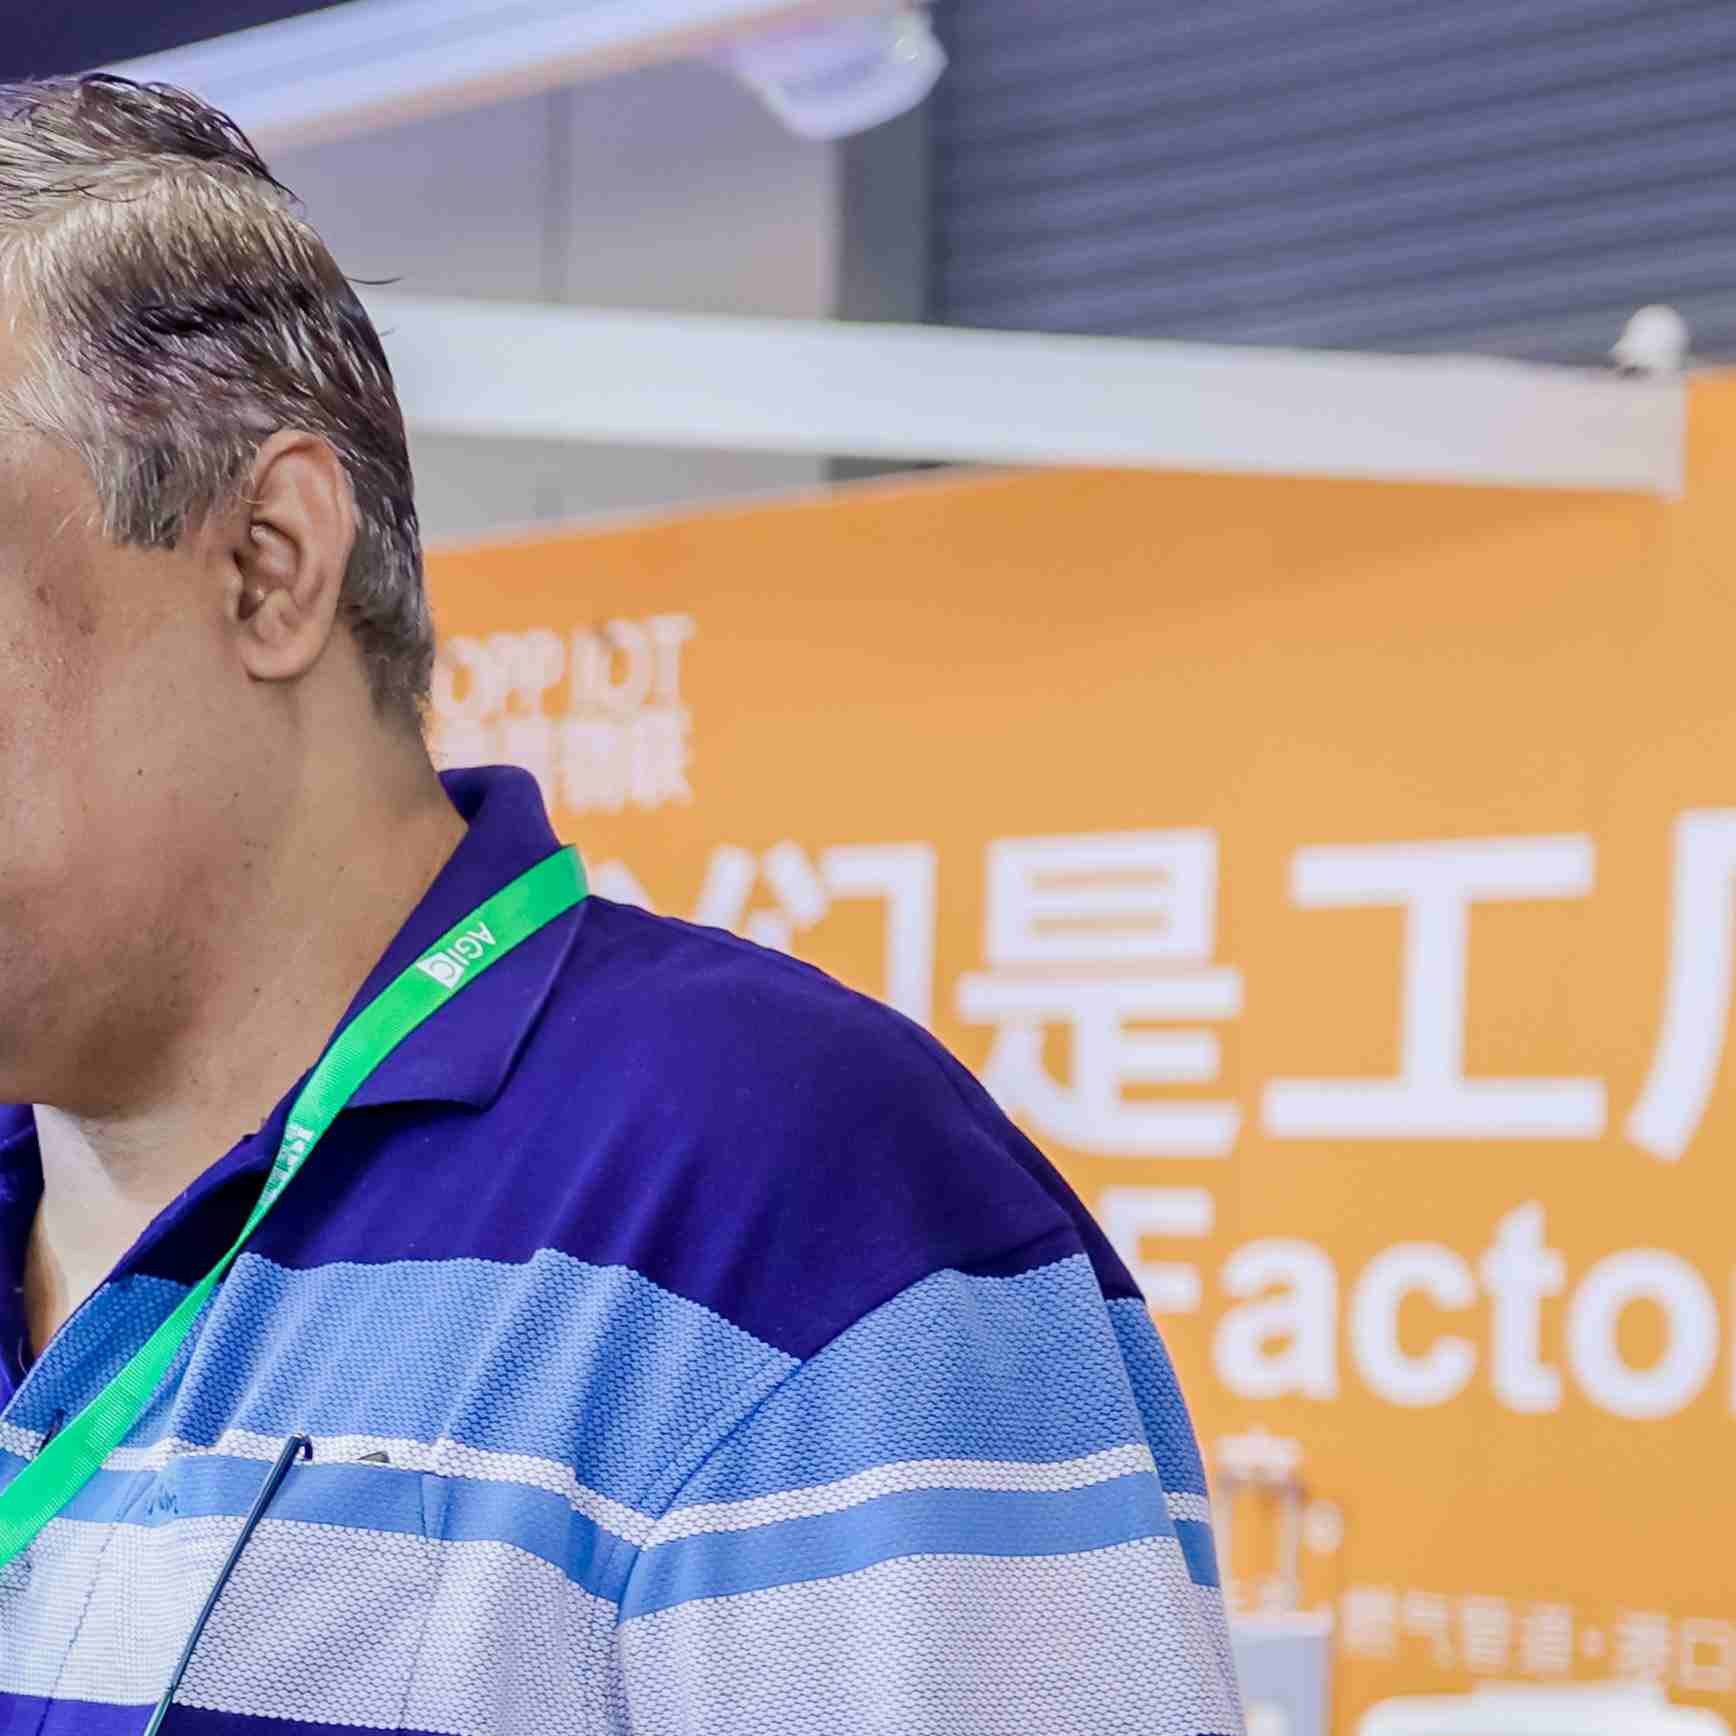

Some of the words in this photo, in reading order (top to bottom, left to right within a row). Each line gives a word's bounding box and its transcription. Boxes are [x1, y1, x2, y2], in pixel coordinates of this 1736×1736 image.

[595, 802, 1736, 1160] 们是工
[1103, 1184, 1736, 1418] Facto
